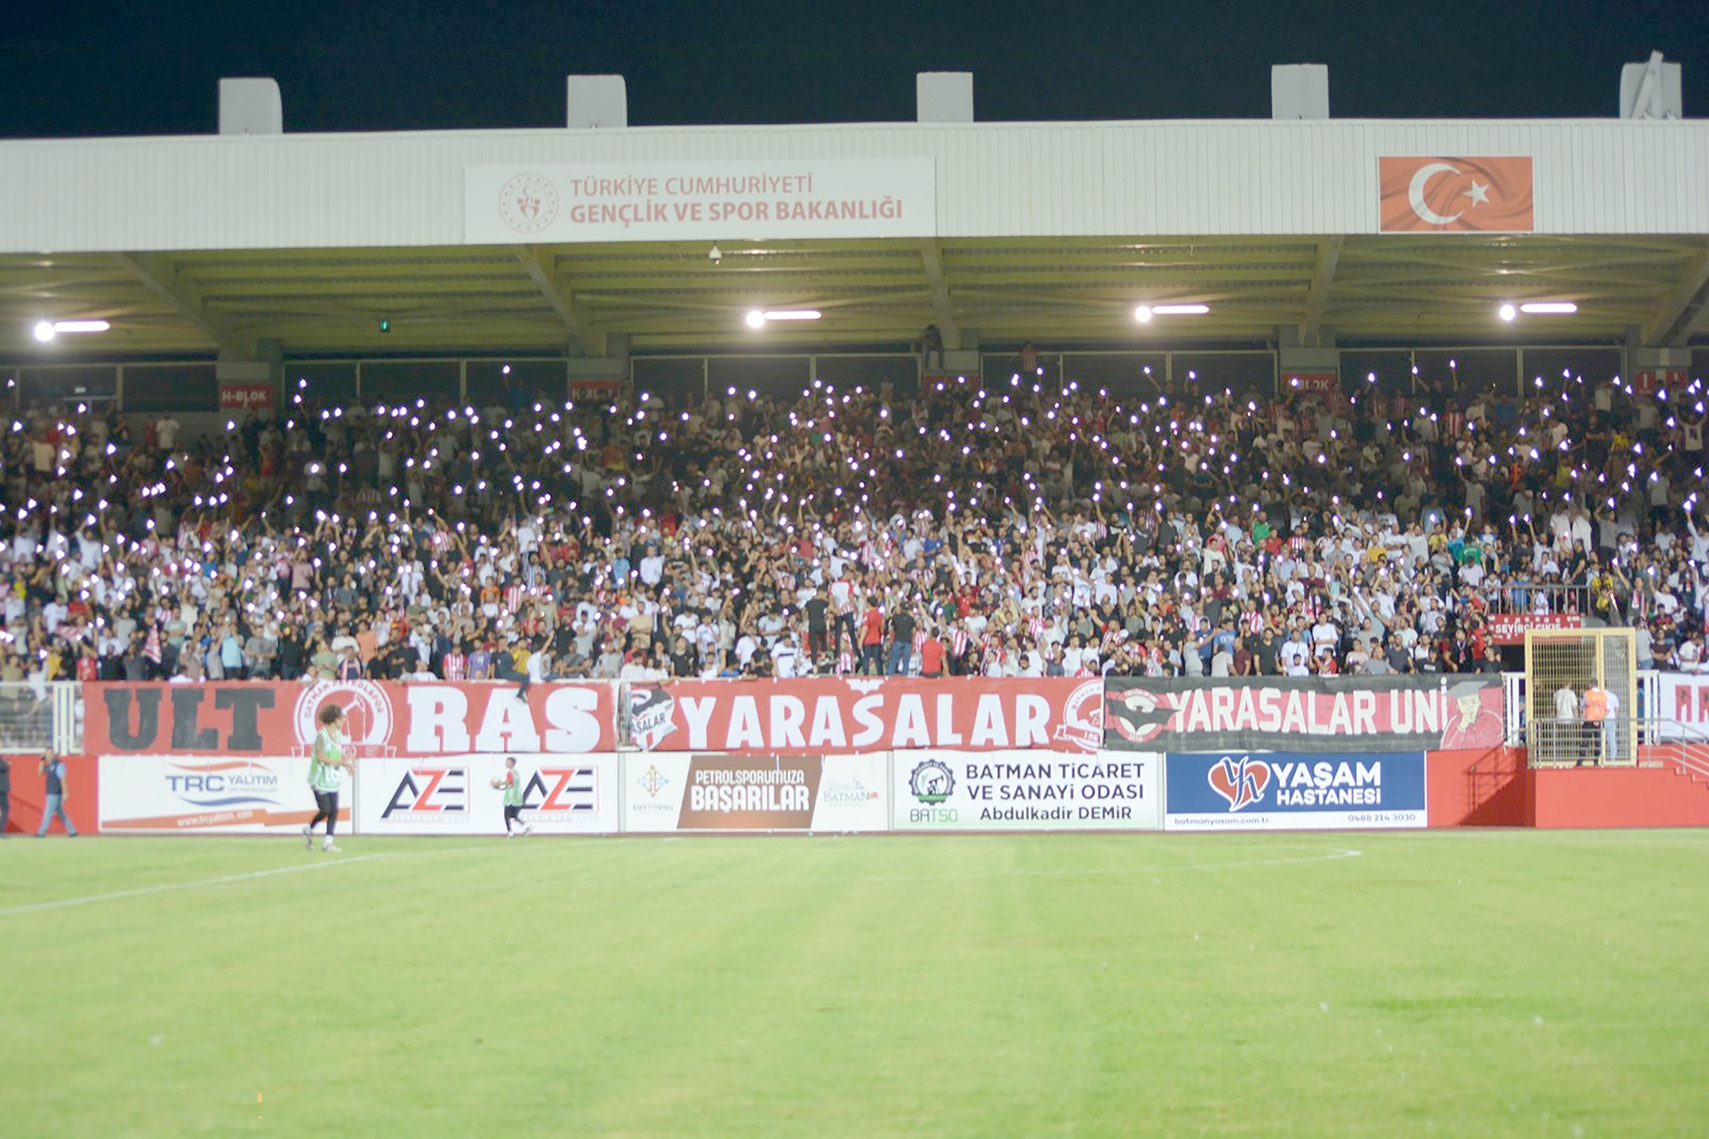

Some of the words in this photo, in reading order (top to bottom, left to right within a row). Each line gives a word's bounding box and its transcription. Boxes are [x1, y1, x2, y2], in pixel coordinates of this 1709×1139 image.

[570, 173, 659, 197] TÜRKİYE
[665, 171, 813, 196] CUMHURİYETİ
[569, 198, 668, 228] GENÇLİK
[671, 203, 702, 222] VE
[708, 201, 769, 221] SPOR
[775, 195, 903, 219] BAKANLIĞI
[104, 688, 275, 751] ULT
[407, 686, 601, 752] RAS
[679, 693, 1050, 749] YARASALAR
[1166, 686, 1377, 735] YARASALAR
[166, 775, 225, 792] TRC
[228, 775, 278, 786] YALITIM
[695, 769, 804, 785] PETROLSPORUMUZA
[966, 764, 1052, 780] BATMAN
[1271, 761, 1381, 789] YAŞAM
[381, 770, 464, 819] AZE
[518, 769, 593, 811] AZE
[690, 785, 810, 813] BAŞARILAR
[967, 785, 994, 801] VE
[1081, 784, 1144, 800] ODASI
[910, 808, 958, 823] BATSO
[980, 806, 1073, 821] Abdulkadir
[1348, 814, 1371, 823] 0488
[1374, 813, 1391, 822] 214
[1392, 813, 1416, 822] 3030
